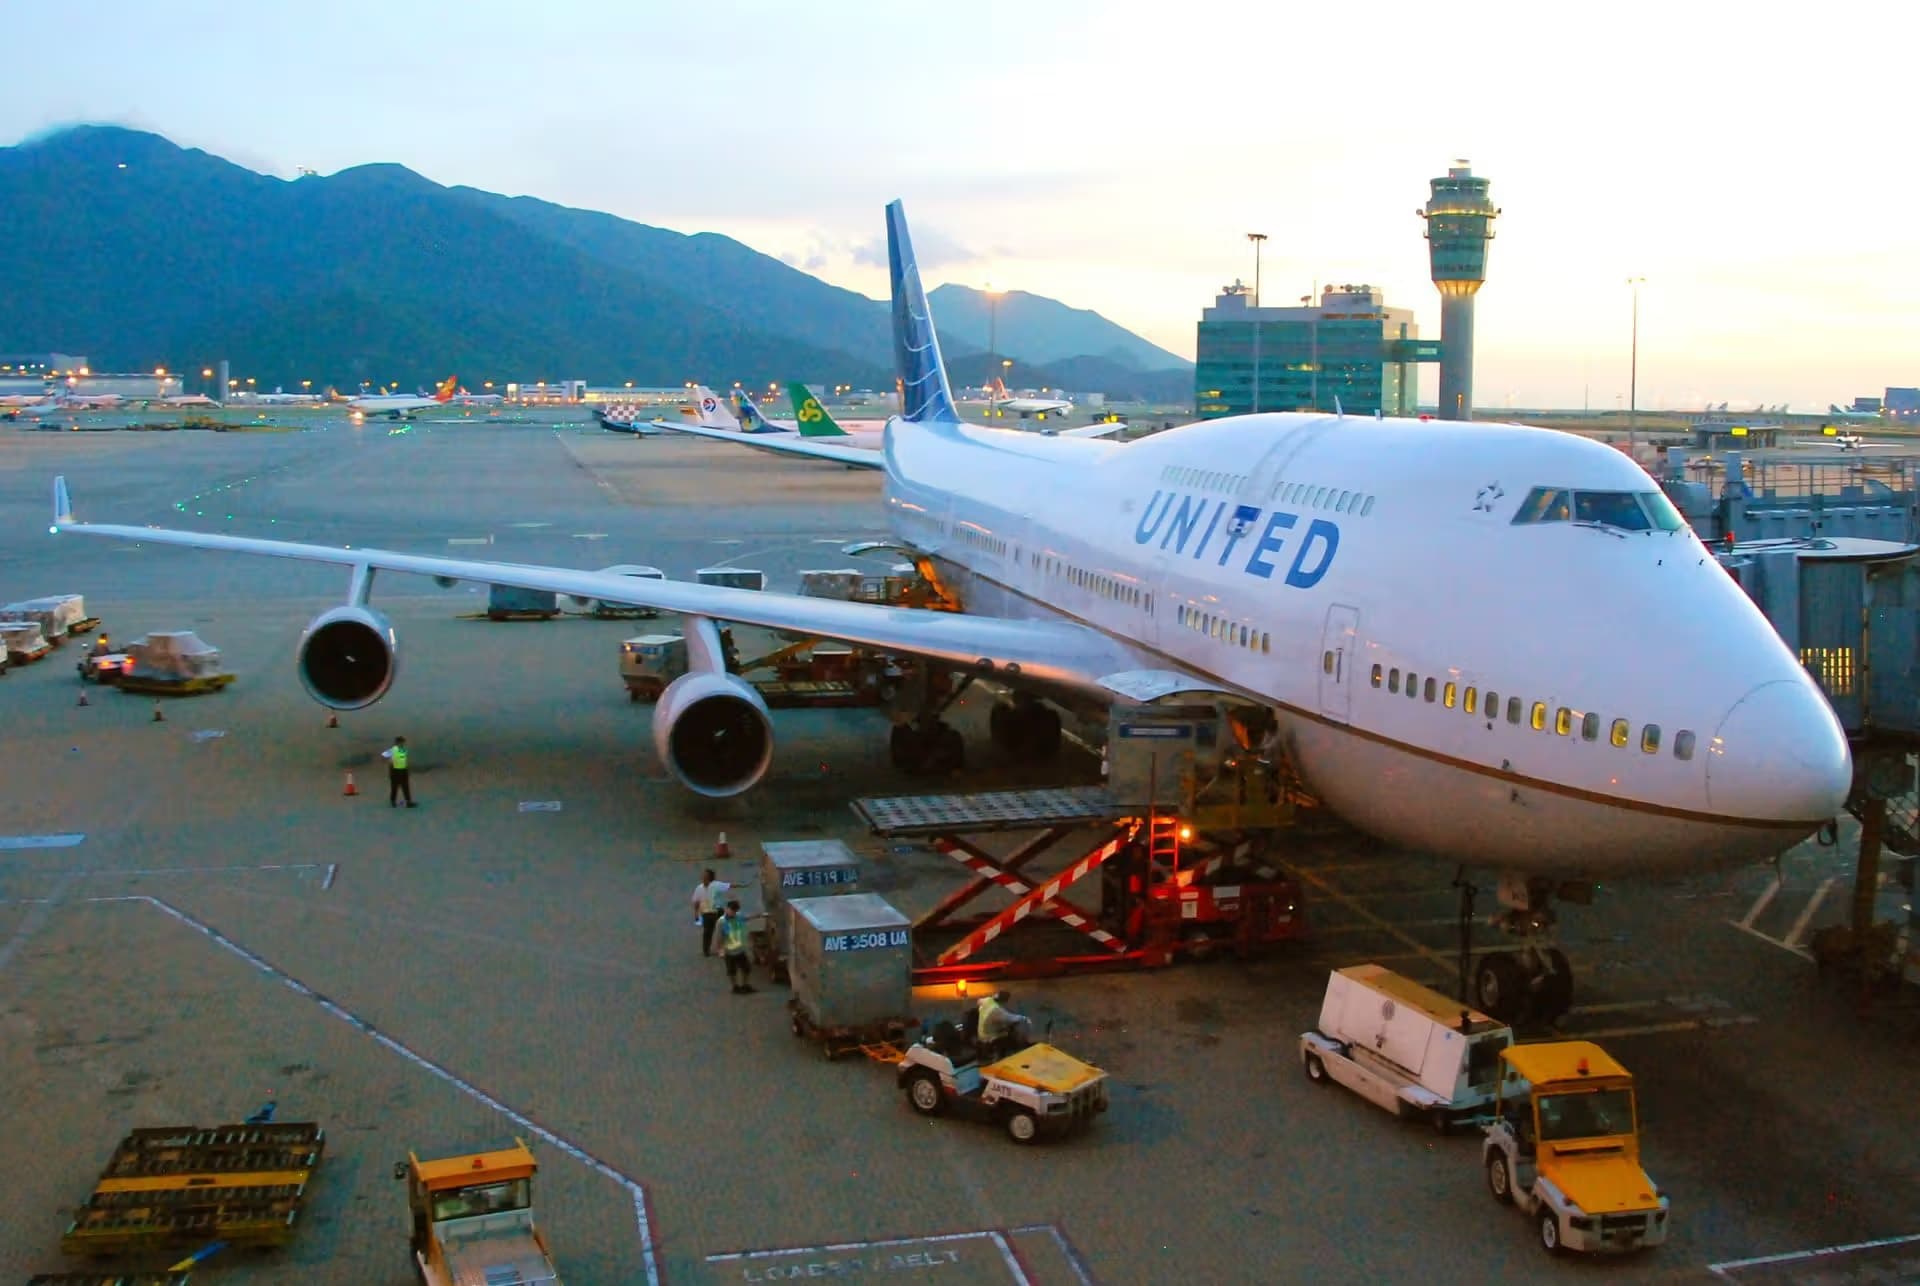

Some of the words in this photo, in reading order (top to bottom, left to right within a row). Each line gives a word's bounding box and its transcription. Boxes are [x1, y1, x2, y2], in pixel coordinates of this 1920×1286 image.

[1135, 490, 1340, 589] UNITED
[783, 871, 804, 886] AVE
[825, 934, 848, 951] AVE
[851, 932, 886, 948] 3508
[890, 930, 907, 945] UA
